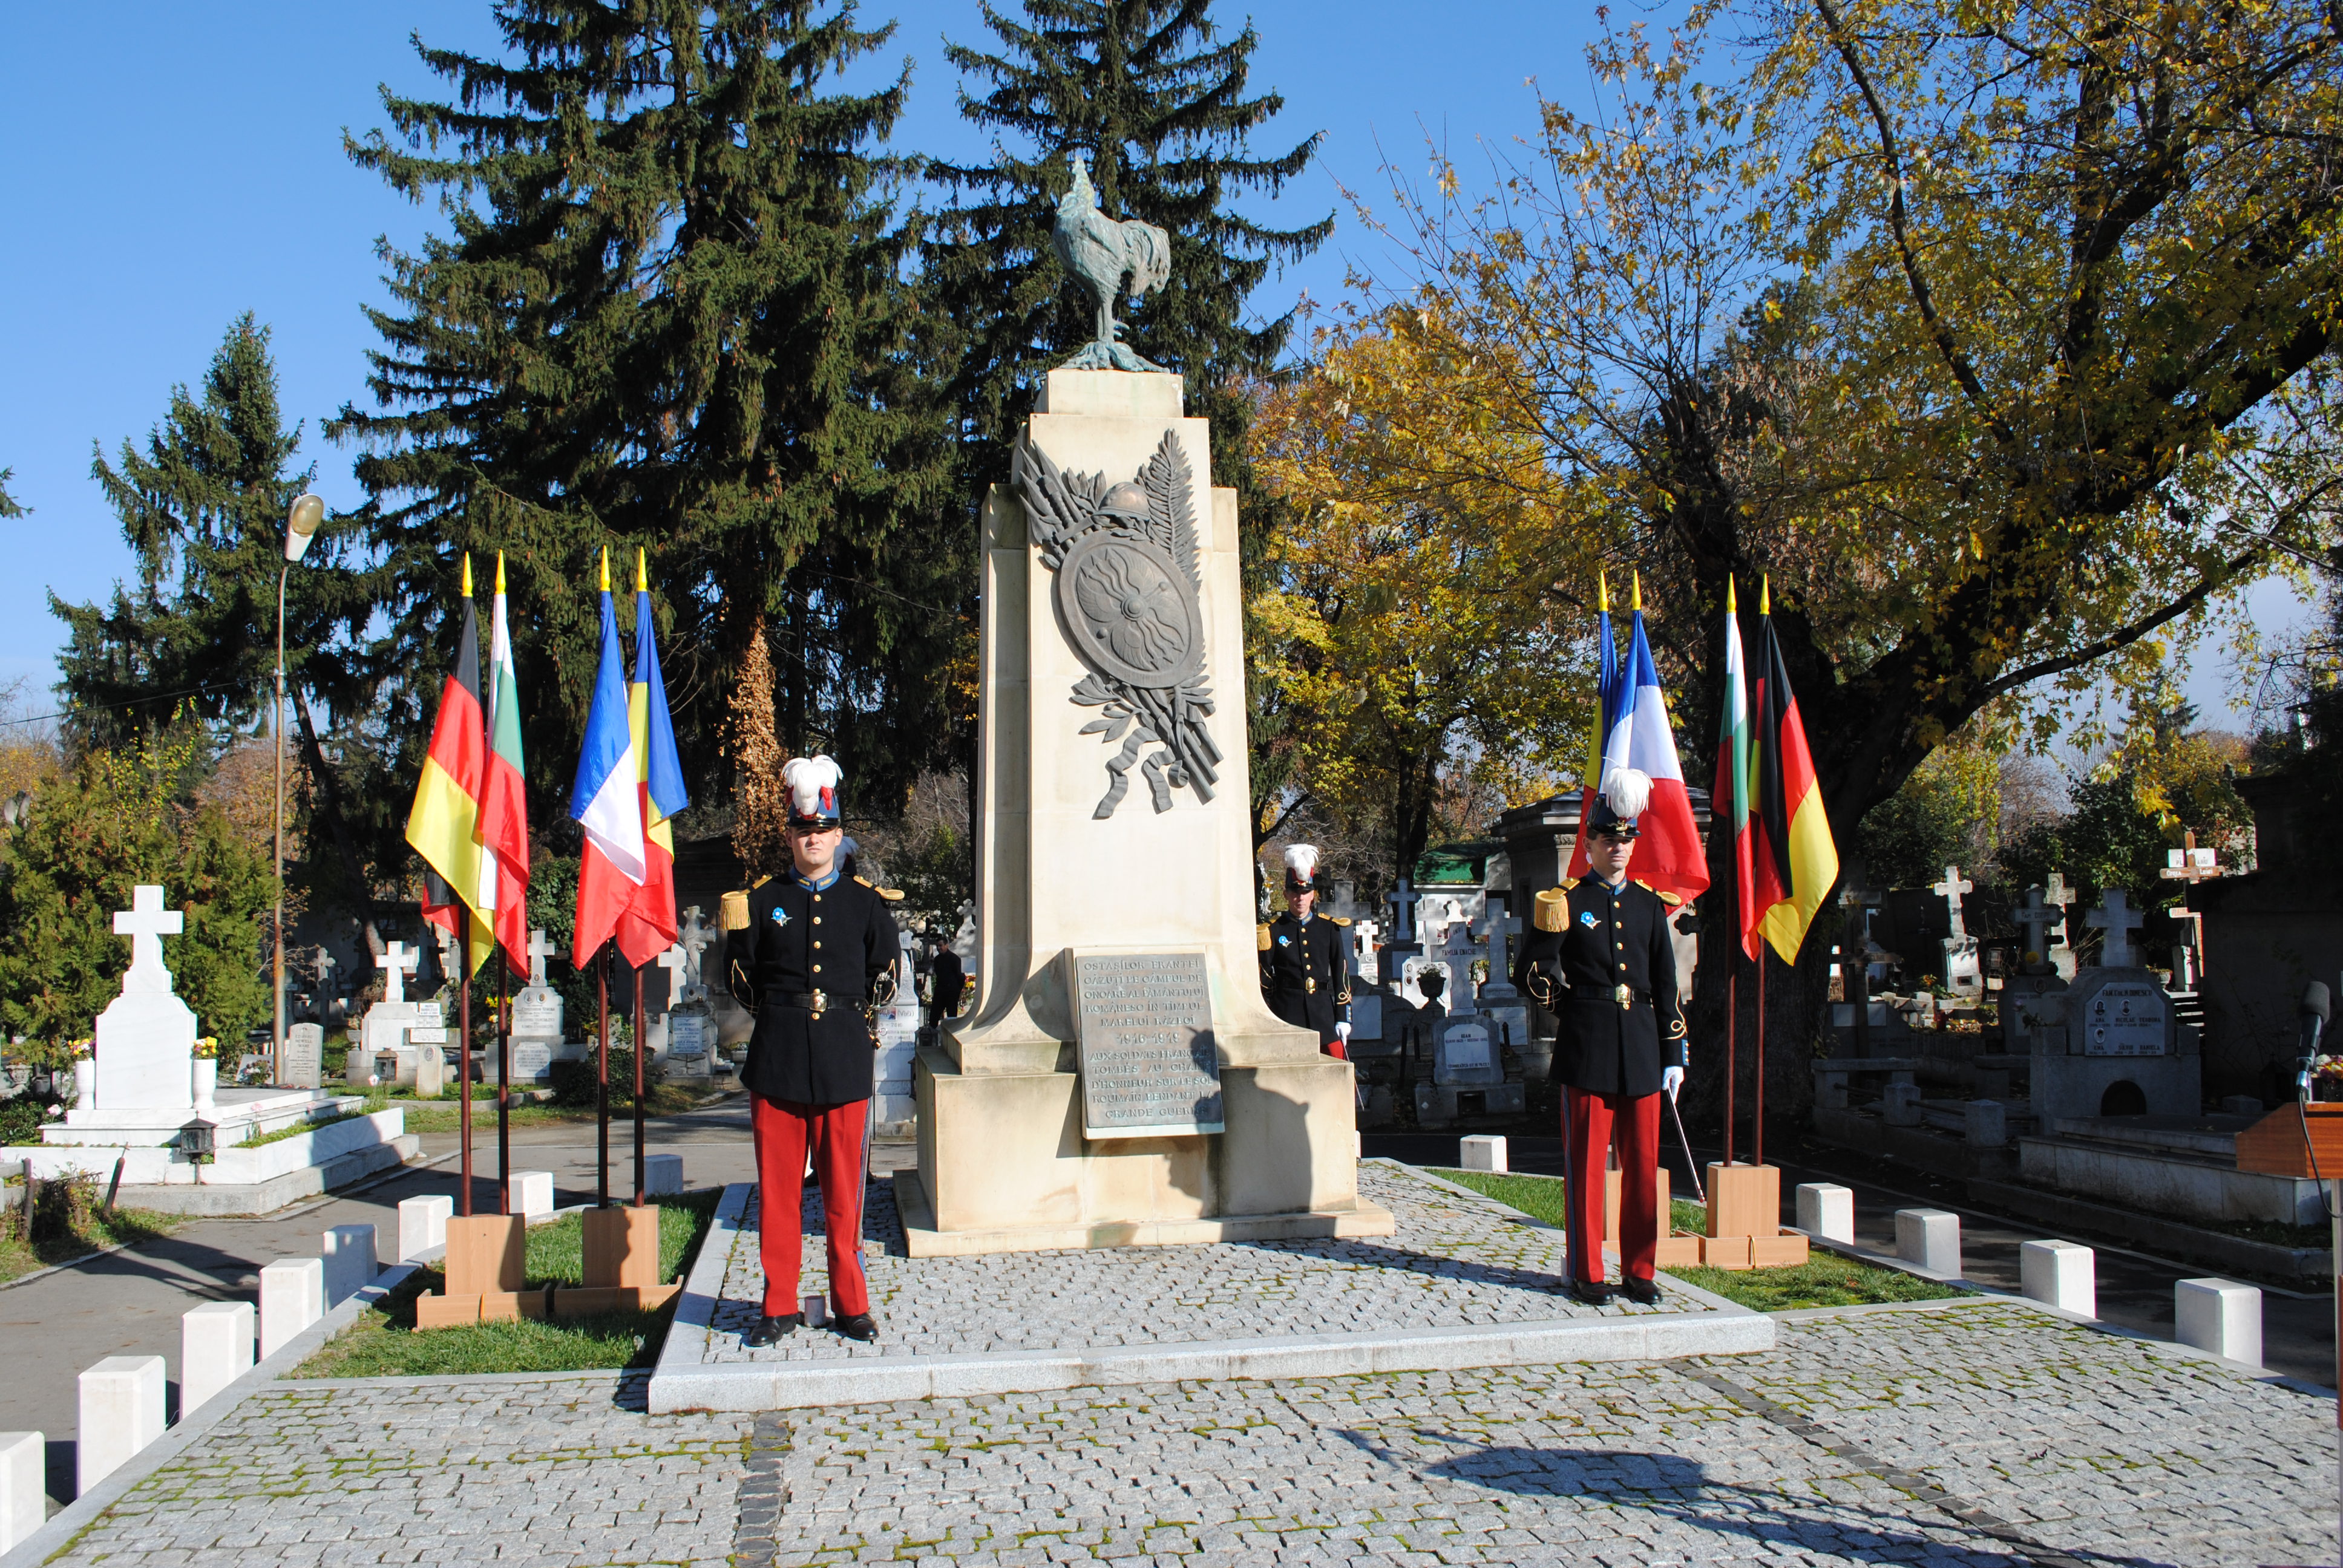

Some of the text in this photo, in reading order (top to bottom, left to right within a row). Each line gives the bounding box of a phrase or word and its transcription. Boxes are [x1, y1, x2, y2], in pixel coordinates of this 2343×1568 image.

[1126, 975, 1139, 984] PE
[1142, 972, 1185, 983] CÂMPUL
[1188, 973, 1202, 982] DE
[1084, 985, 1204, 999] ONOARE AL PĂMÂNTULUI
[1086, 1000, 1144, 1013] ROMÂNESC
[1162, 1001, 1204, 1011] TIMPUL
[1101, 1014, 1195, 1027] MARELUI RĂZBOI
[1089, 1051, 1112, 1062] AUX
[1113, 1050, 1158, 1060] SOLDATS
[1147, 1063, 1162, 1073] AU
[1092, 1076, 1213, 1089] D'HONNEUR SUR LE SOL
[1092, 1090, 1213, 1103] ROUMAIN PENDANT LA
[1105, 1108, 1153, 1119] GRANDE
